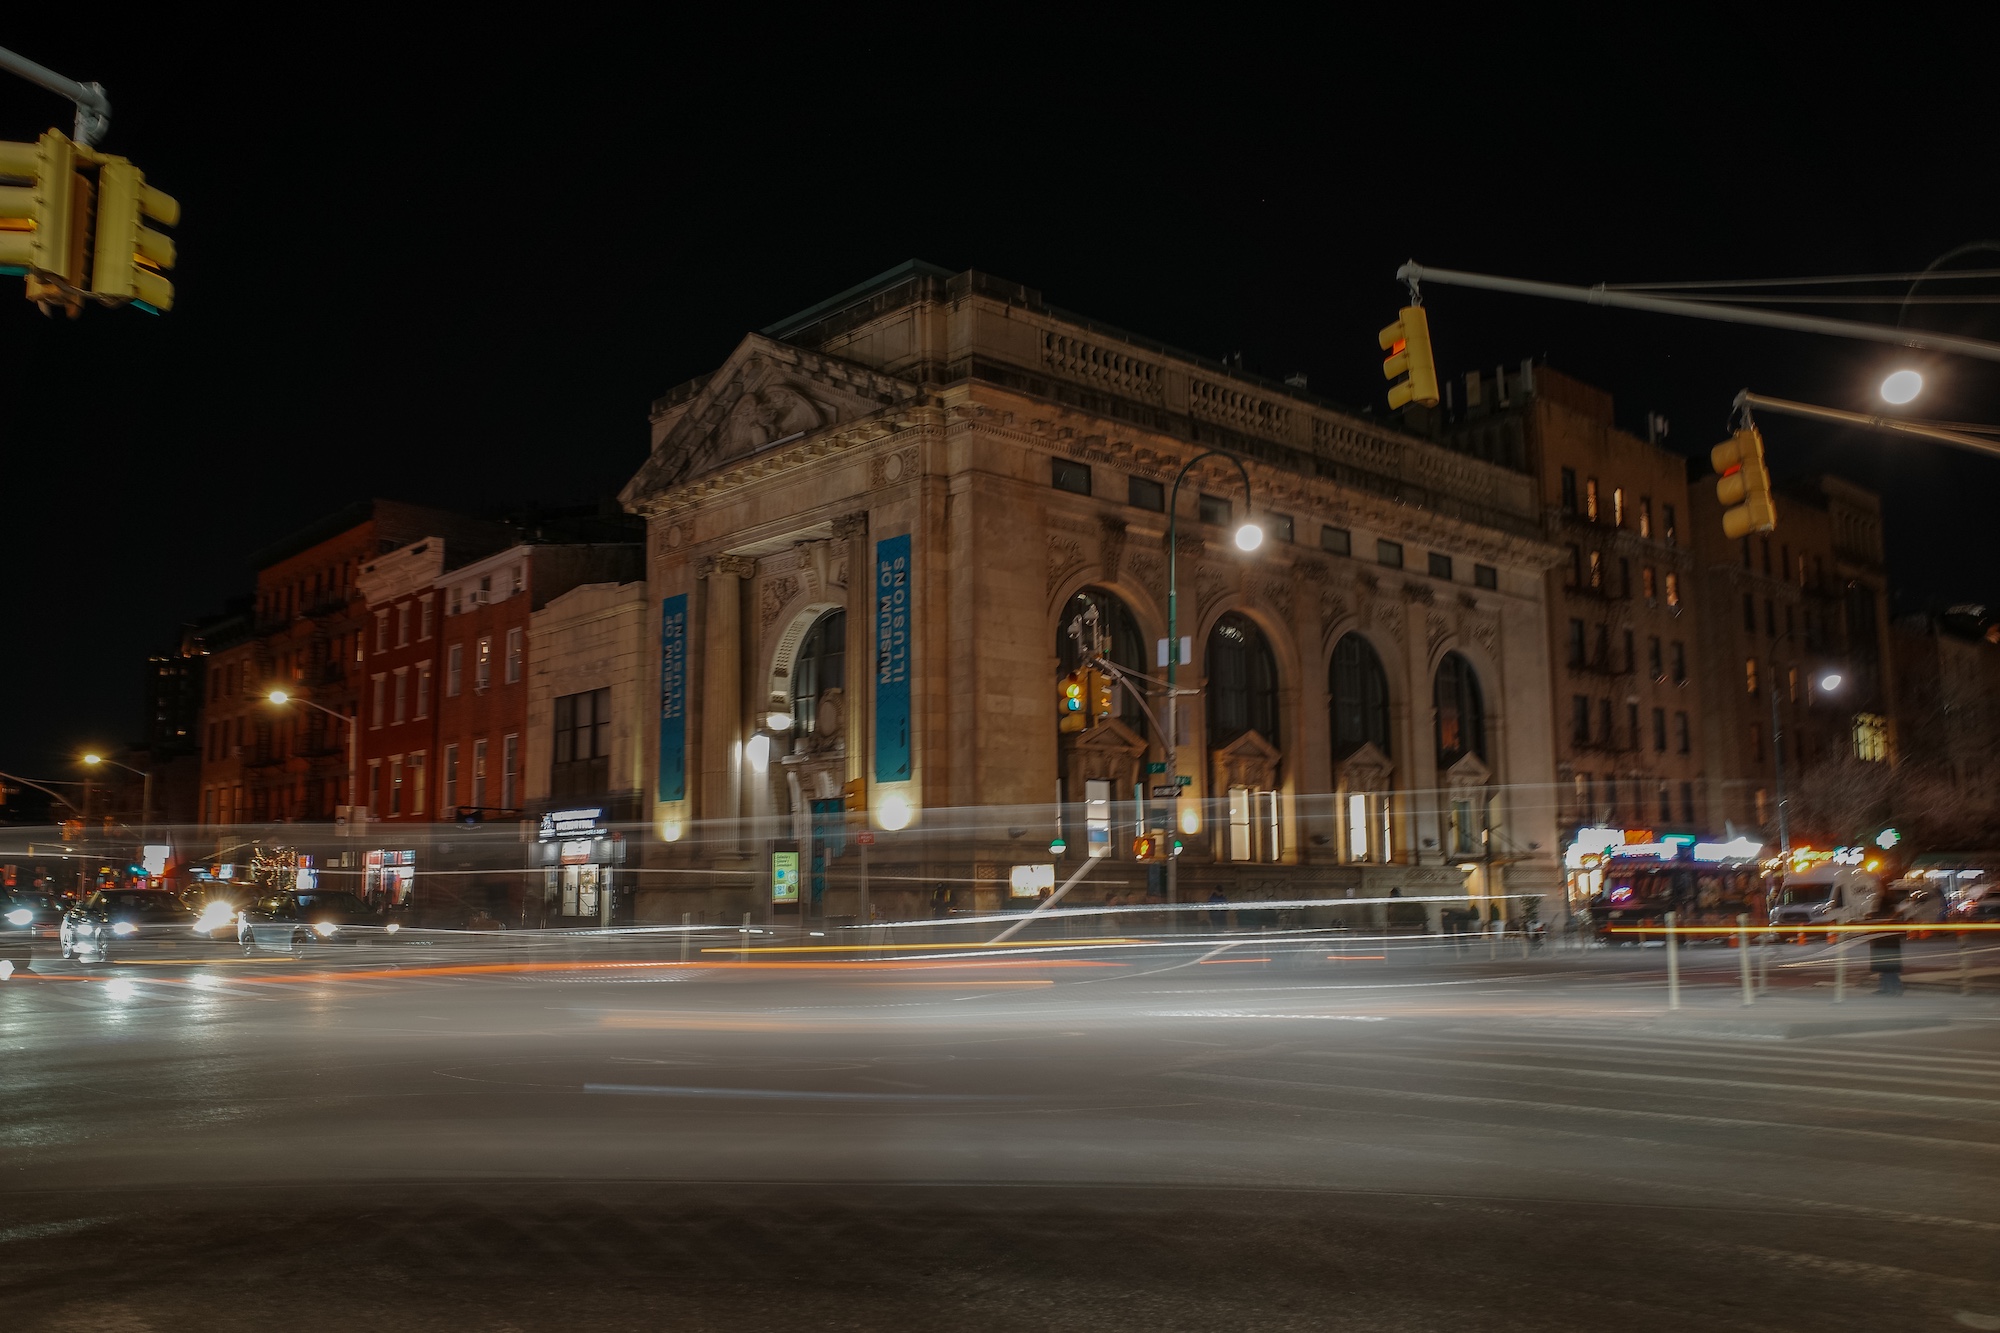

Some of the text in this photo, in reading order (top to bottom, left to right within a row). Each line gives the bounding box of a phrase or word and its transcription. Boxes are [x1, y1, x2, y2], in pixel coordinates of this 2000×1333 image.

[664, 615, 673, 719] MUSEUM OF
[673, 612, 684, 718] ILLUSIONS
[880, 560, 892, 685] MUSEUM OF
[893, 556, 905, 682] ILLUSIONS
